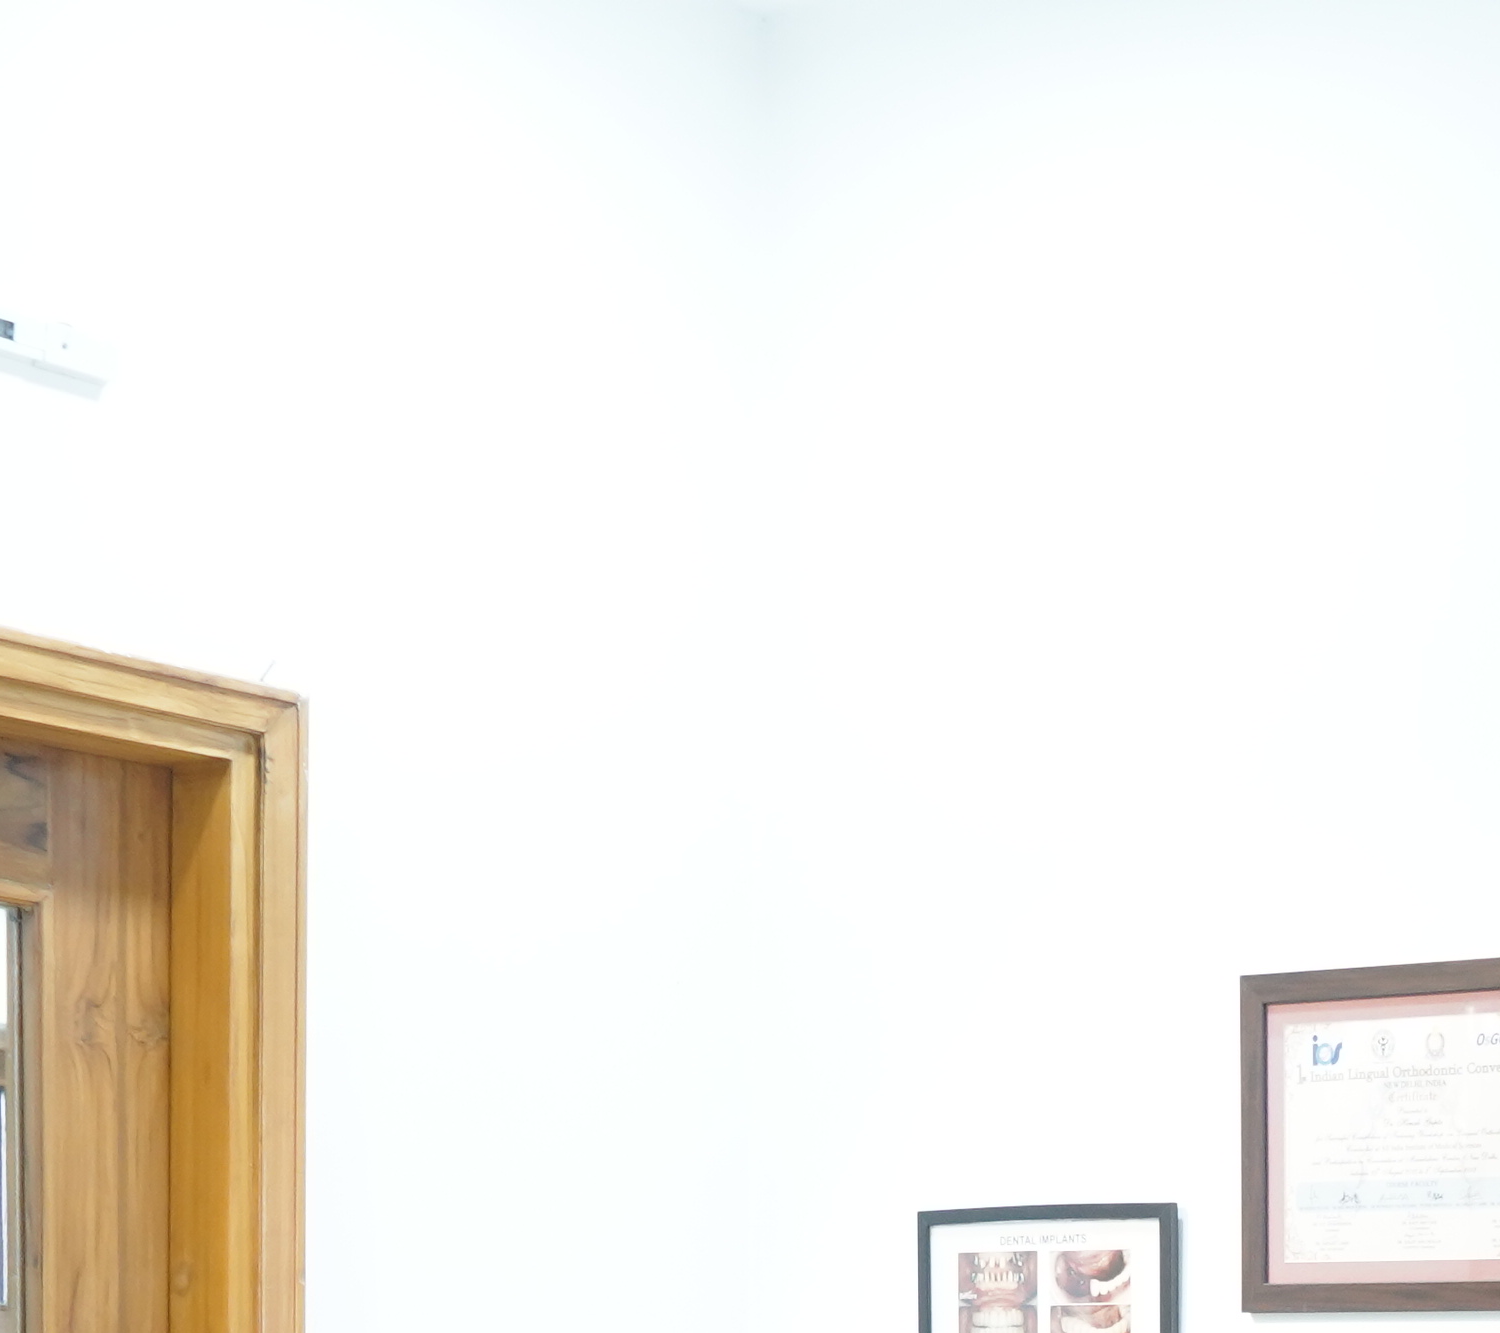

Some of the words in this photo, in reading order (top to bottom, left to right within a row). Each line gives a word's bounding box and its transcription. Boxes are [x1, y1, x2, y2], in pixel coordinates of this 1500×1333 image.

[1310, 1071, 1344, 1082] Indian
[1348, 1066, 1390, 1083] Lingual
[1393, 1063, 1463, 1078] Orthodontic
[1426, 1079, 1447, 1087] INDIA
[1000, 1236, 1037, 1246] DENTAL
[1039, 1234, 1087, 1244] IMPLANTS
